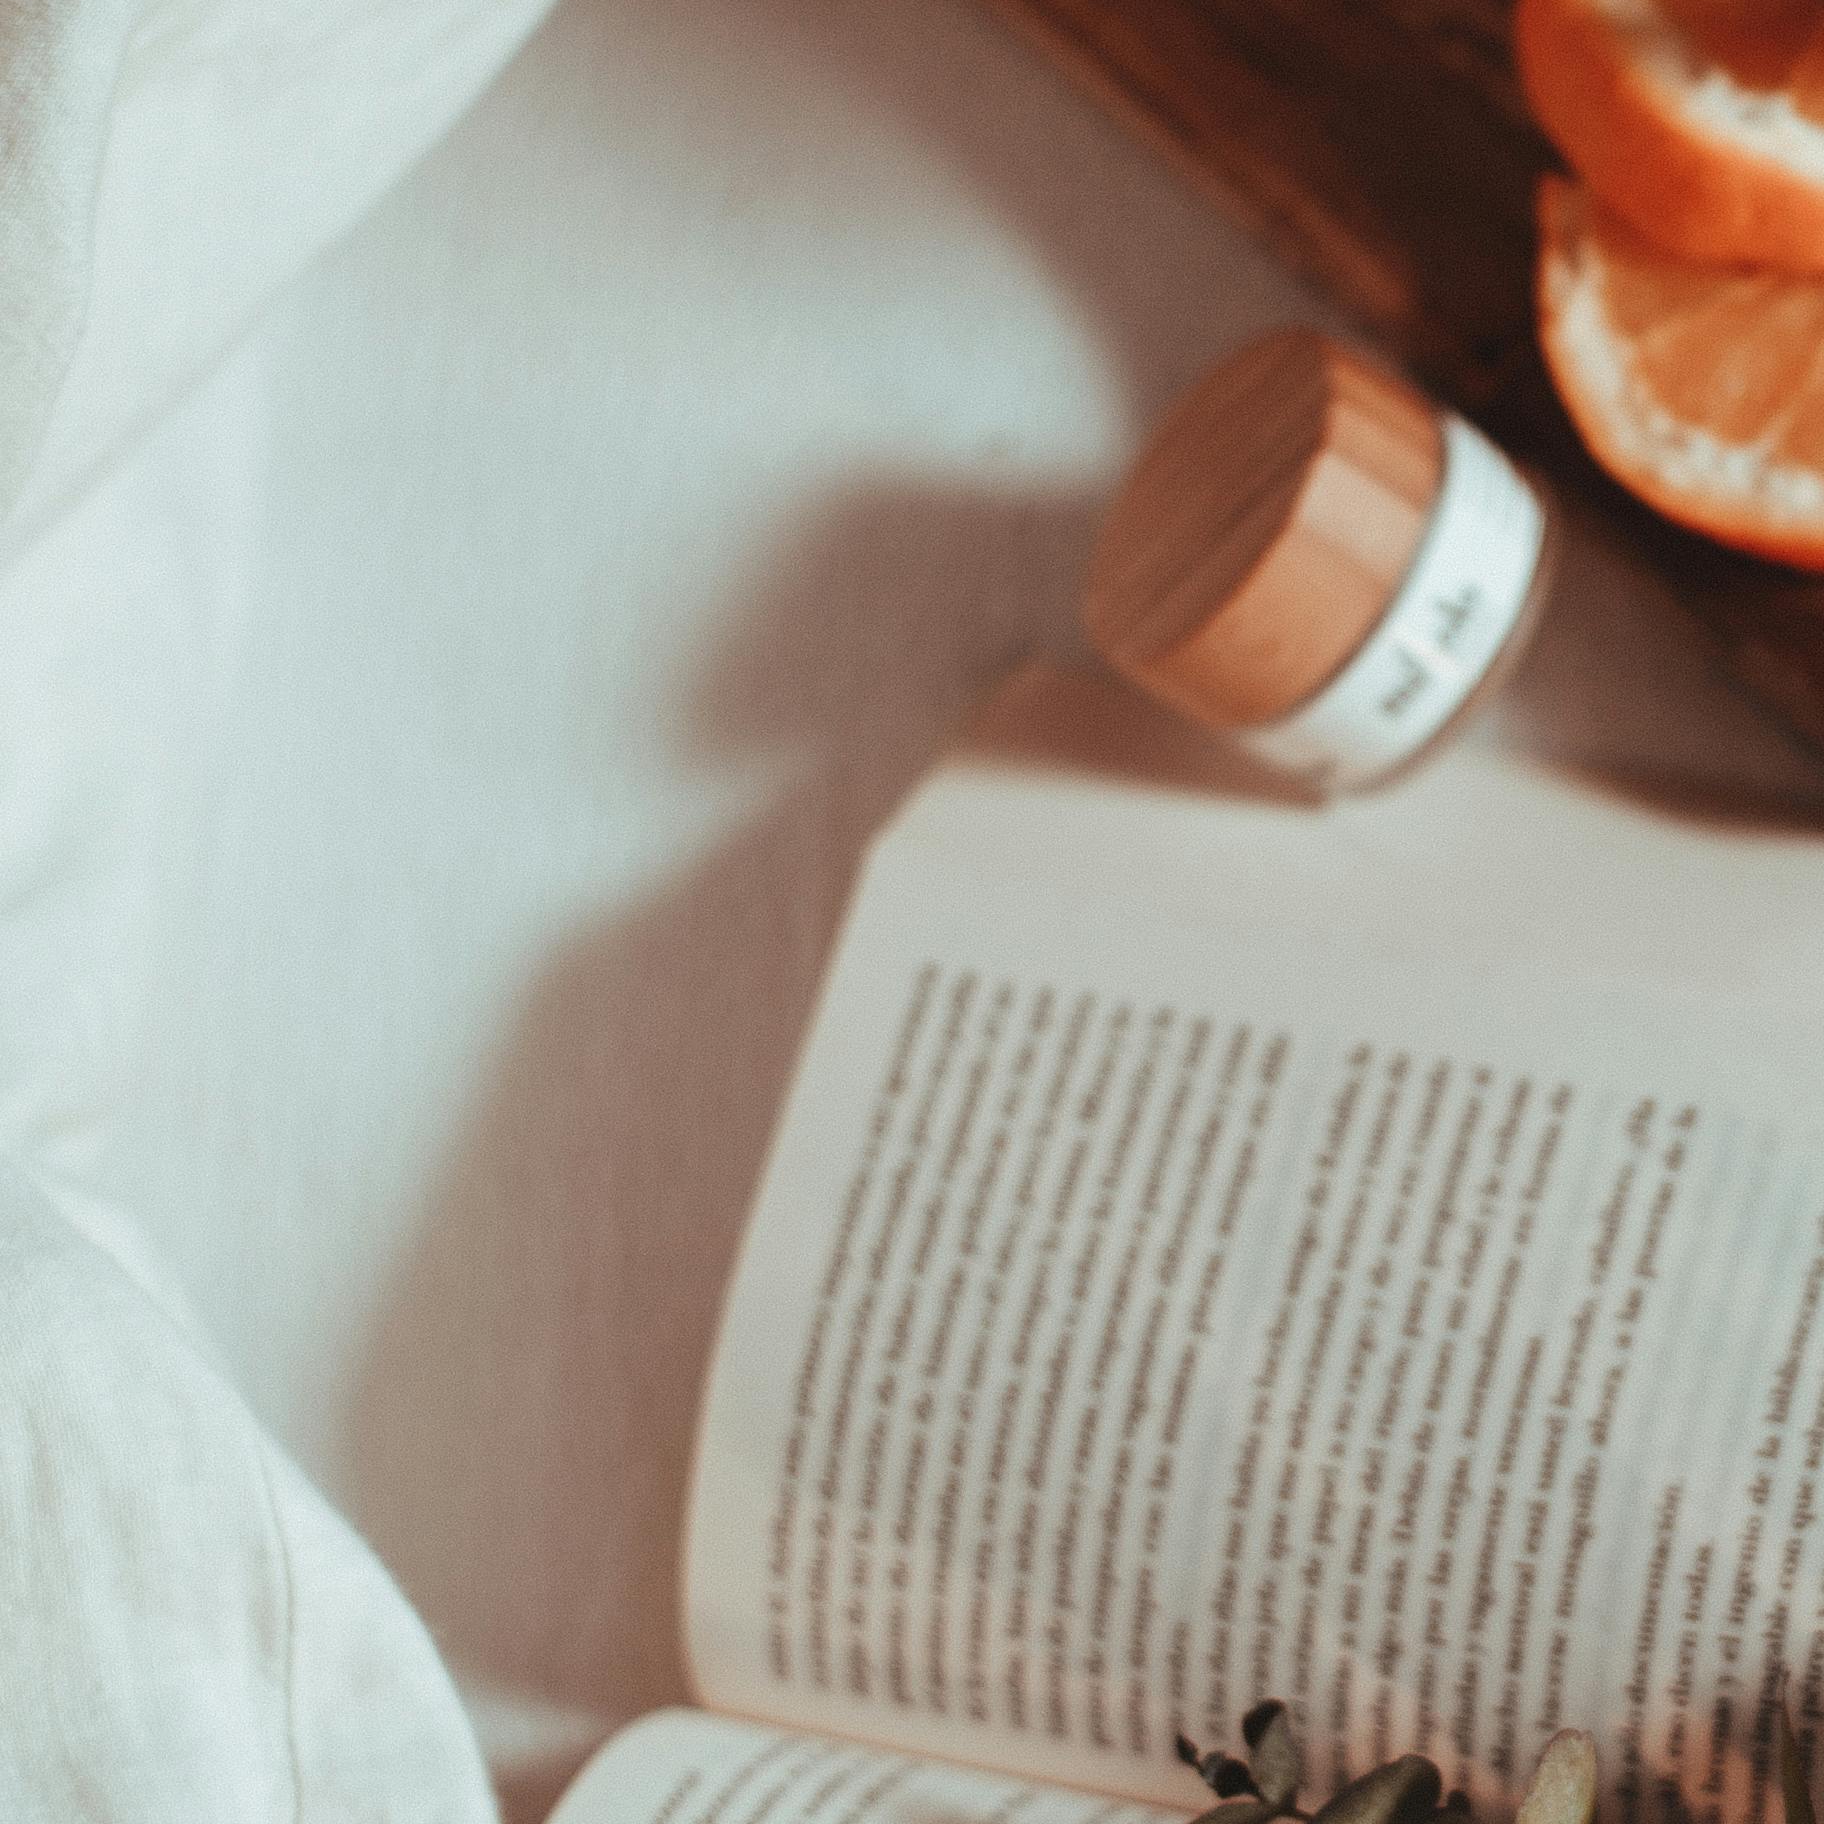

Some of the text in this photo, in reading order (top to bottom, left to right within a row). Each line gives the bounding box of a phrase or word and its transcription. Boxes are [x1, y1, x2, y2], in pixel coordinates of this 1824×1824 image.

[1789, 1482, 1816, 1532] que
[1679, 1544, 1716, 1625] todos.
[1723, 1515, 1765, 1626] ingenio
[1777, 1538, 1804, 1591] con
